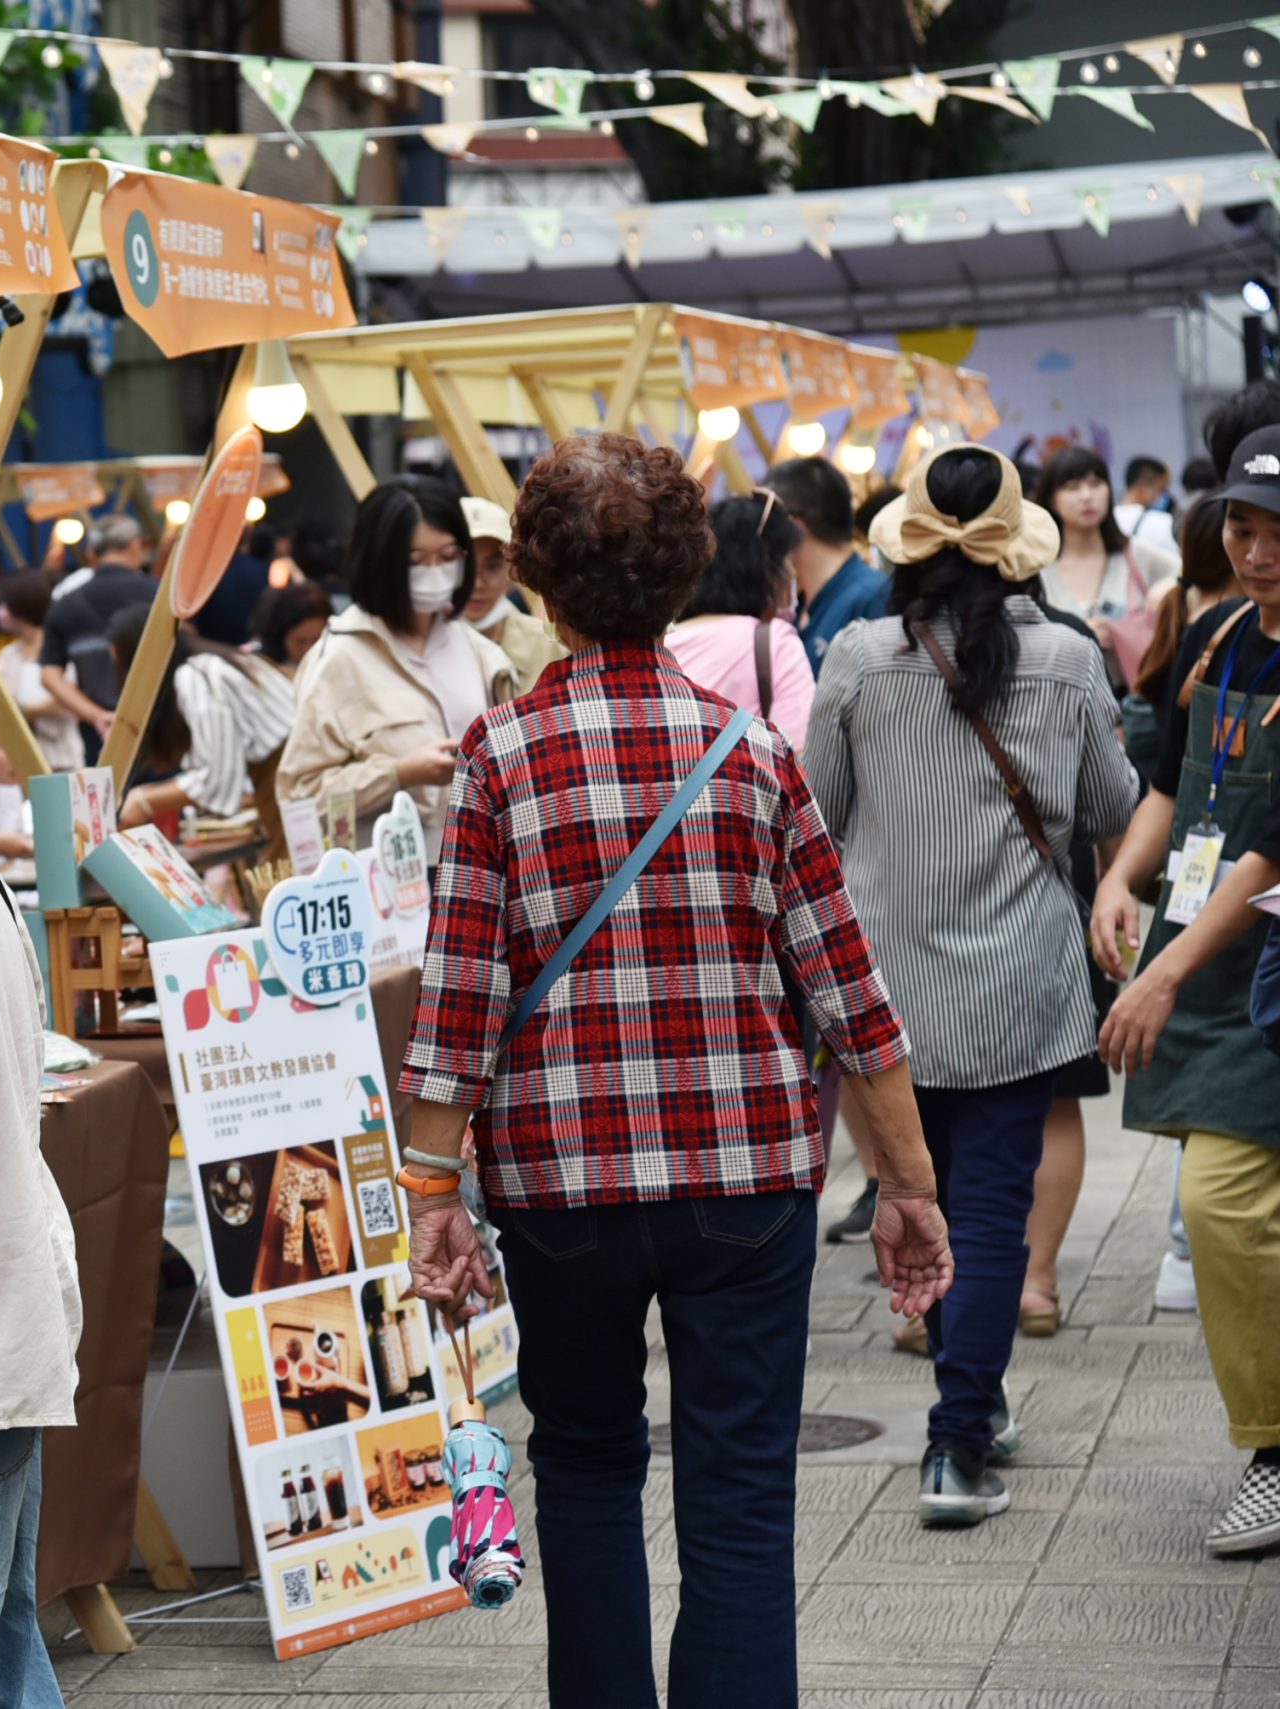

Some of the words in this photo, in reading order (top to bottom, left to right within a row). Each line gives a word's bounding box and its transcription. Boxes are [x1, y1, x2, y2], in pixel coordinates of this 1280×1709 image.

[132, 233, 151, 285] 9
[297, 894, 351, 936] 17:15
[299, 931, 365, 964] 多元即享
[195, 1042, 253, 1068] 社團法人
